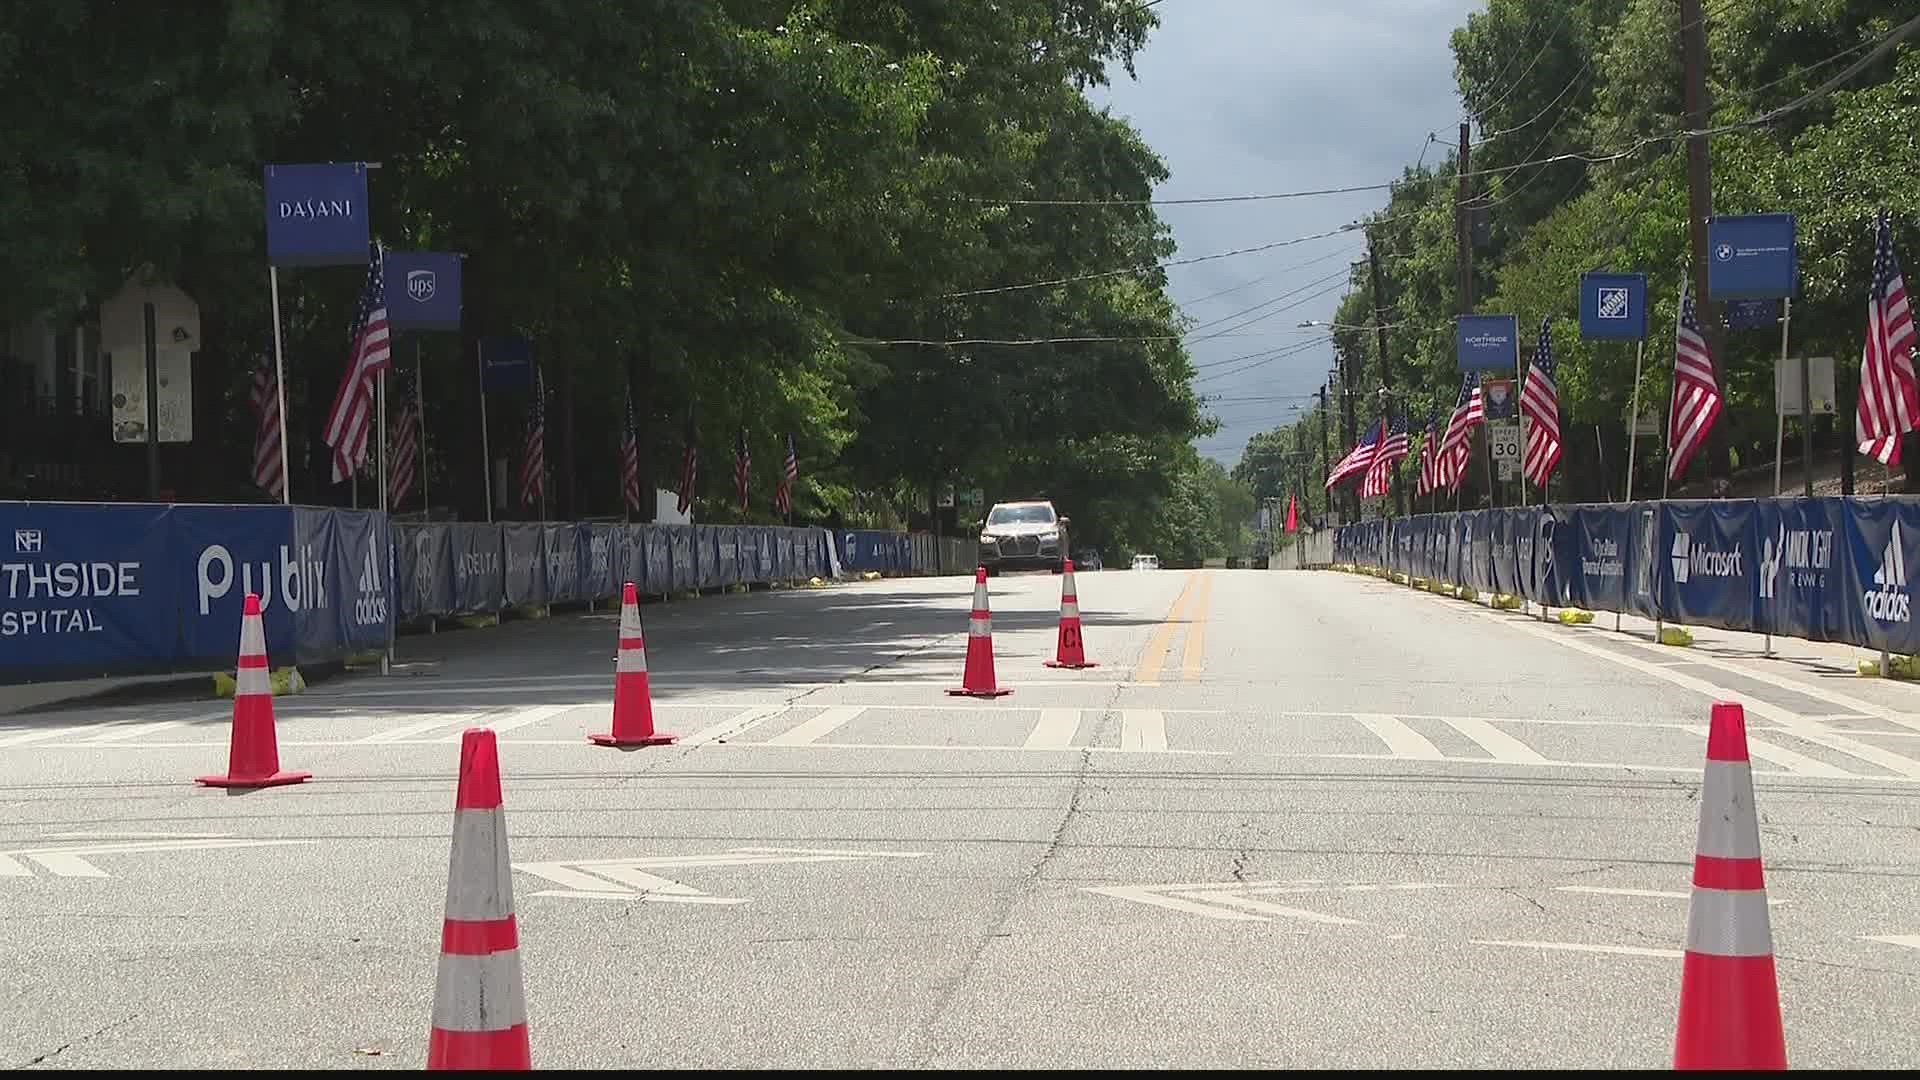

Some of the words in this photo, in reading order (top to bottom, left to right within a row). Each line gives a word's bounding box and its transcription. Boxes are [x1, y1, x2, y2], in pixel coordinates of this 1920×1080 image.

[280, 198, 351, 221] DASANI
[1495, 443, 1517, 456] 30
[465, 552, 498, 576] DELTA
[197, 544, 328, 615] Publix
[1864, 583, 1911, 623] adidas
